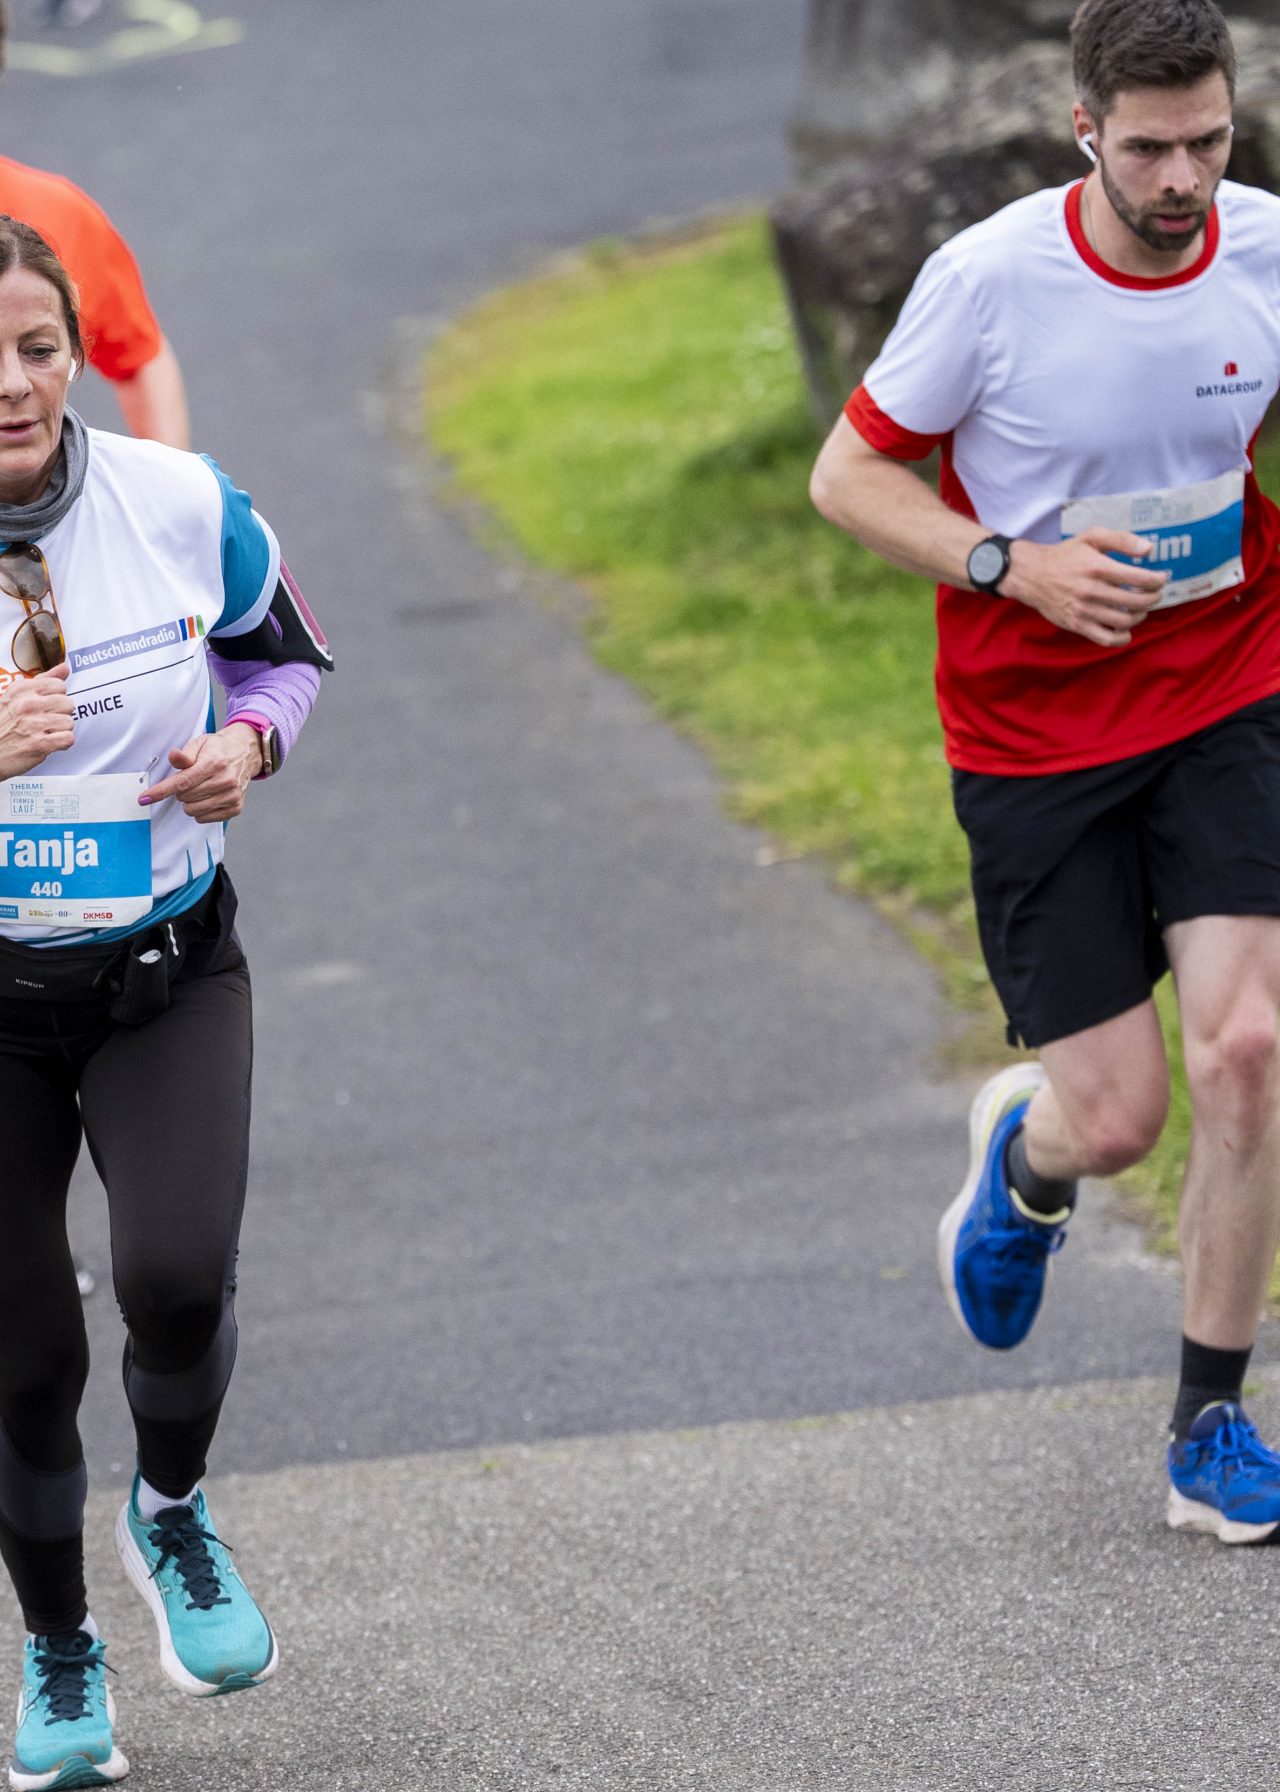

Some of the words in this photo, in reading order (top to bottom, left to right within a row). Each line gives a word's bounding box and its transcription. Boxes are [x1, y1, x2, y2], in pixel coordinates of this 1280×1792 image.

[1196, 378, 1263, 397] DATAGROUP
[75, 628, 176, 668] Deutschlandradio
[13, 804, 35, 814] LAUF
[30, 881, 62, 897] 440
[15, 978, 45, 989] KIPRUN
